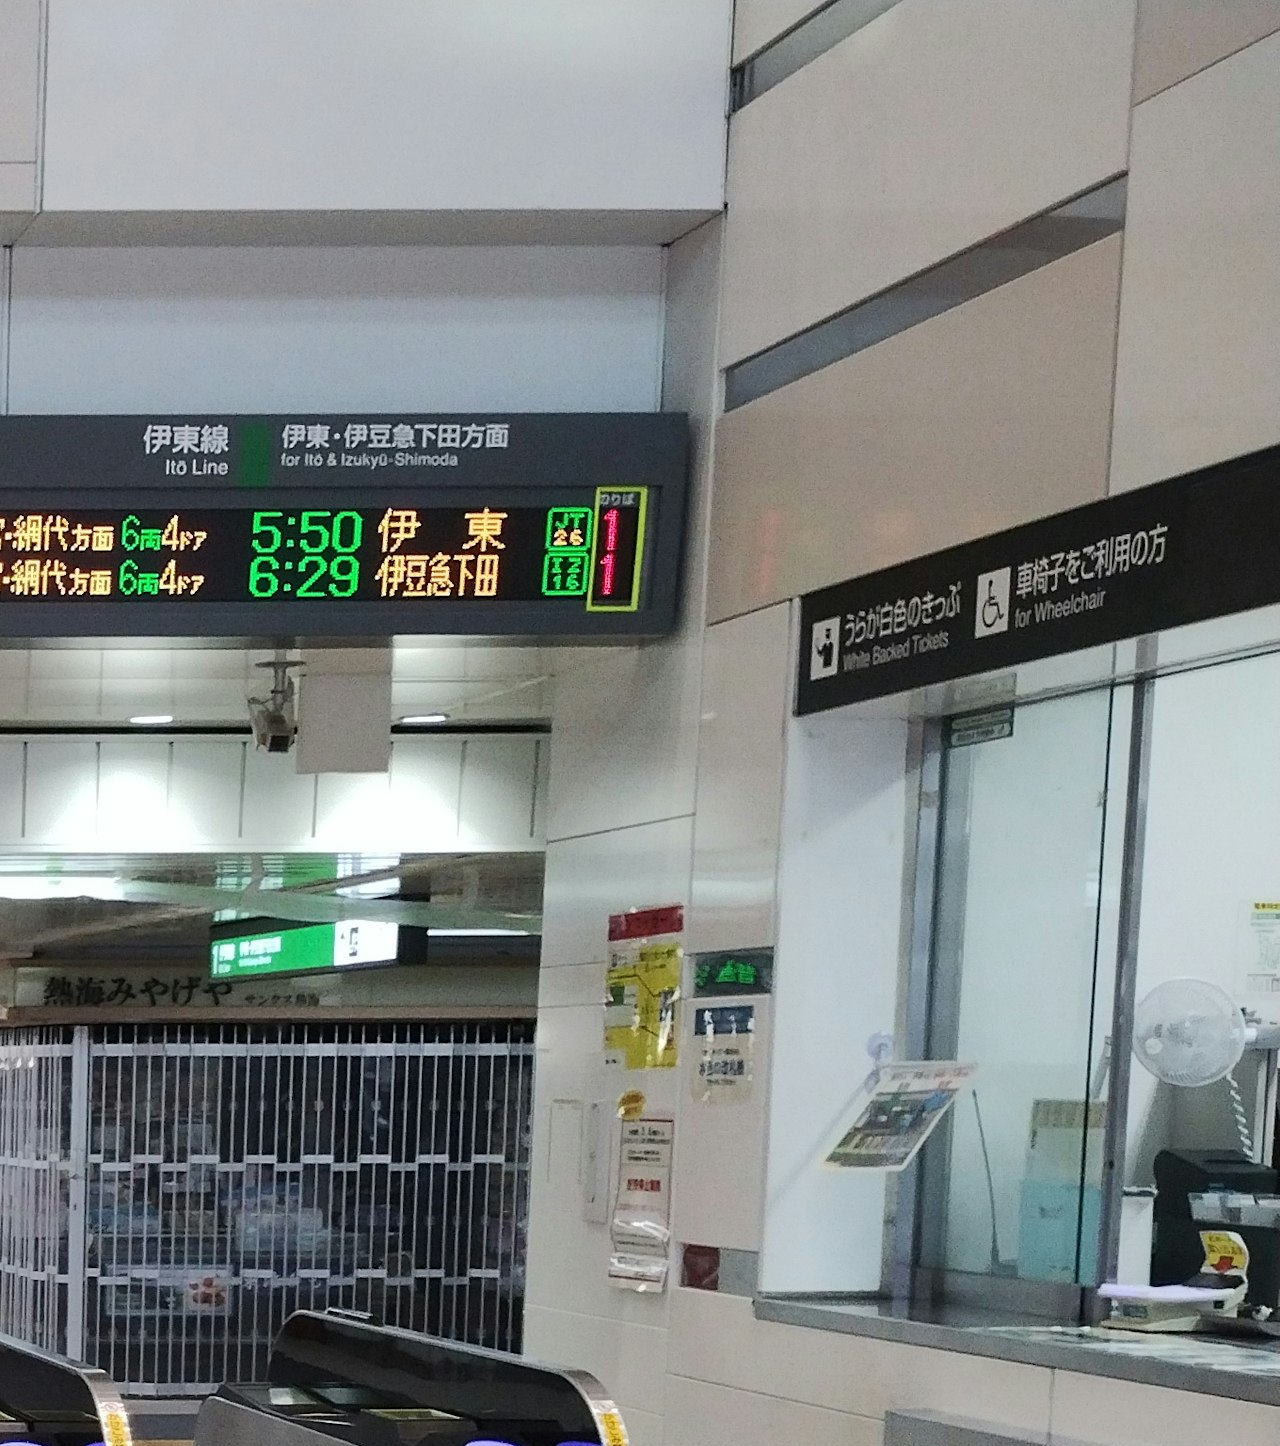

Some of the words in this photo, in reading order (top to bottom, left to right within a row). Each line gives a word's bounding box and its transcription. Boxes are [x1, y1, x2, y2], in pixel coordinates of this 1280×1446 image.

[142, 424, 230, 455] 伊東線
[281, 423, 509, 449] 伊東・伊豆急下田方面
[192, 458, 229, 476] Line
[280, 452, 300, 467] for
[327, 453, 337, 467] &
[251, 510, 364, 554] 5:50
[603, 507, 619, 551] 1
[248, 554, 360, 598] 6:29
[374, 552, 500, 597] 伊豆急下田
[599, 551, 615, 596] 1
[1015, 522, 1169, 600] 車椅子をご利用の方
[844, 580, 962, 647] うらが白色のきっぷ
[1014, 606, 1031, 629] for
[1034, 588, 1106, 626] Wheelchair
[872, 637, 911, 665] Backed
[911, 630, 950, 654] Tickets
